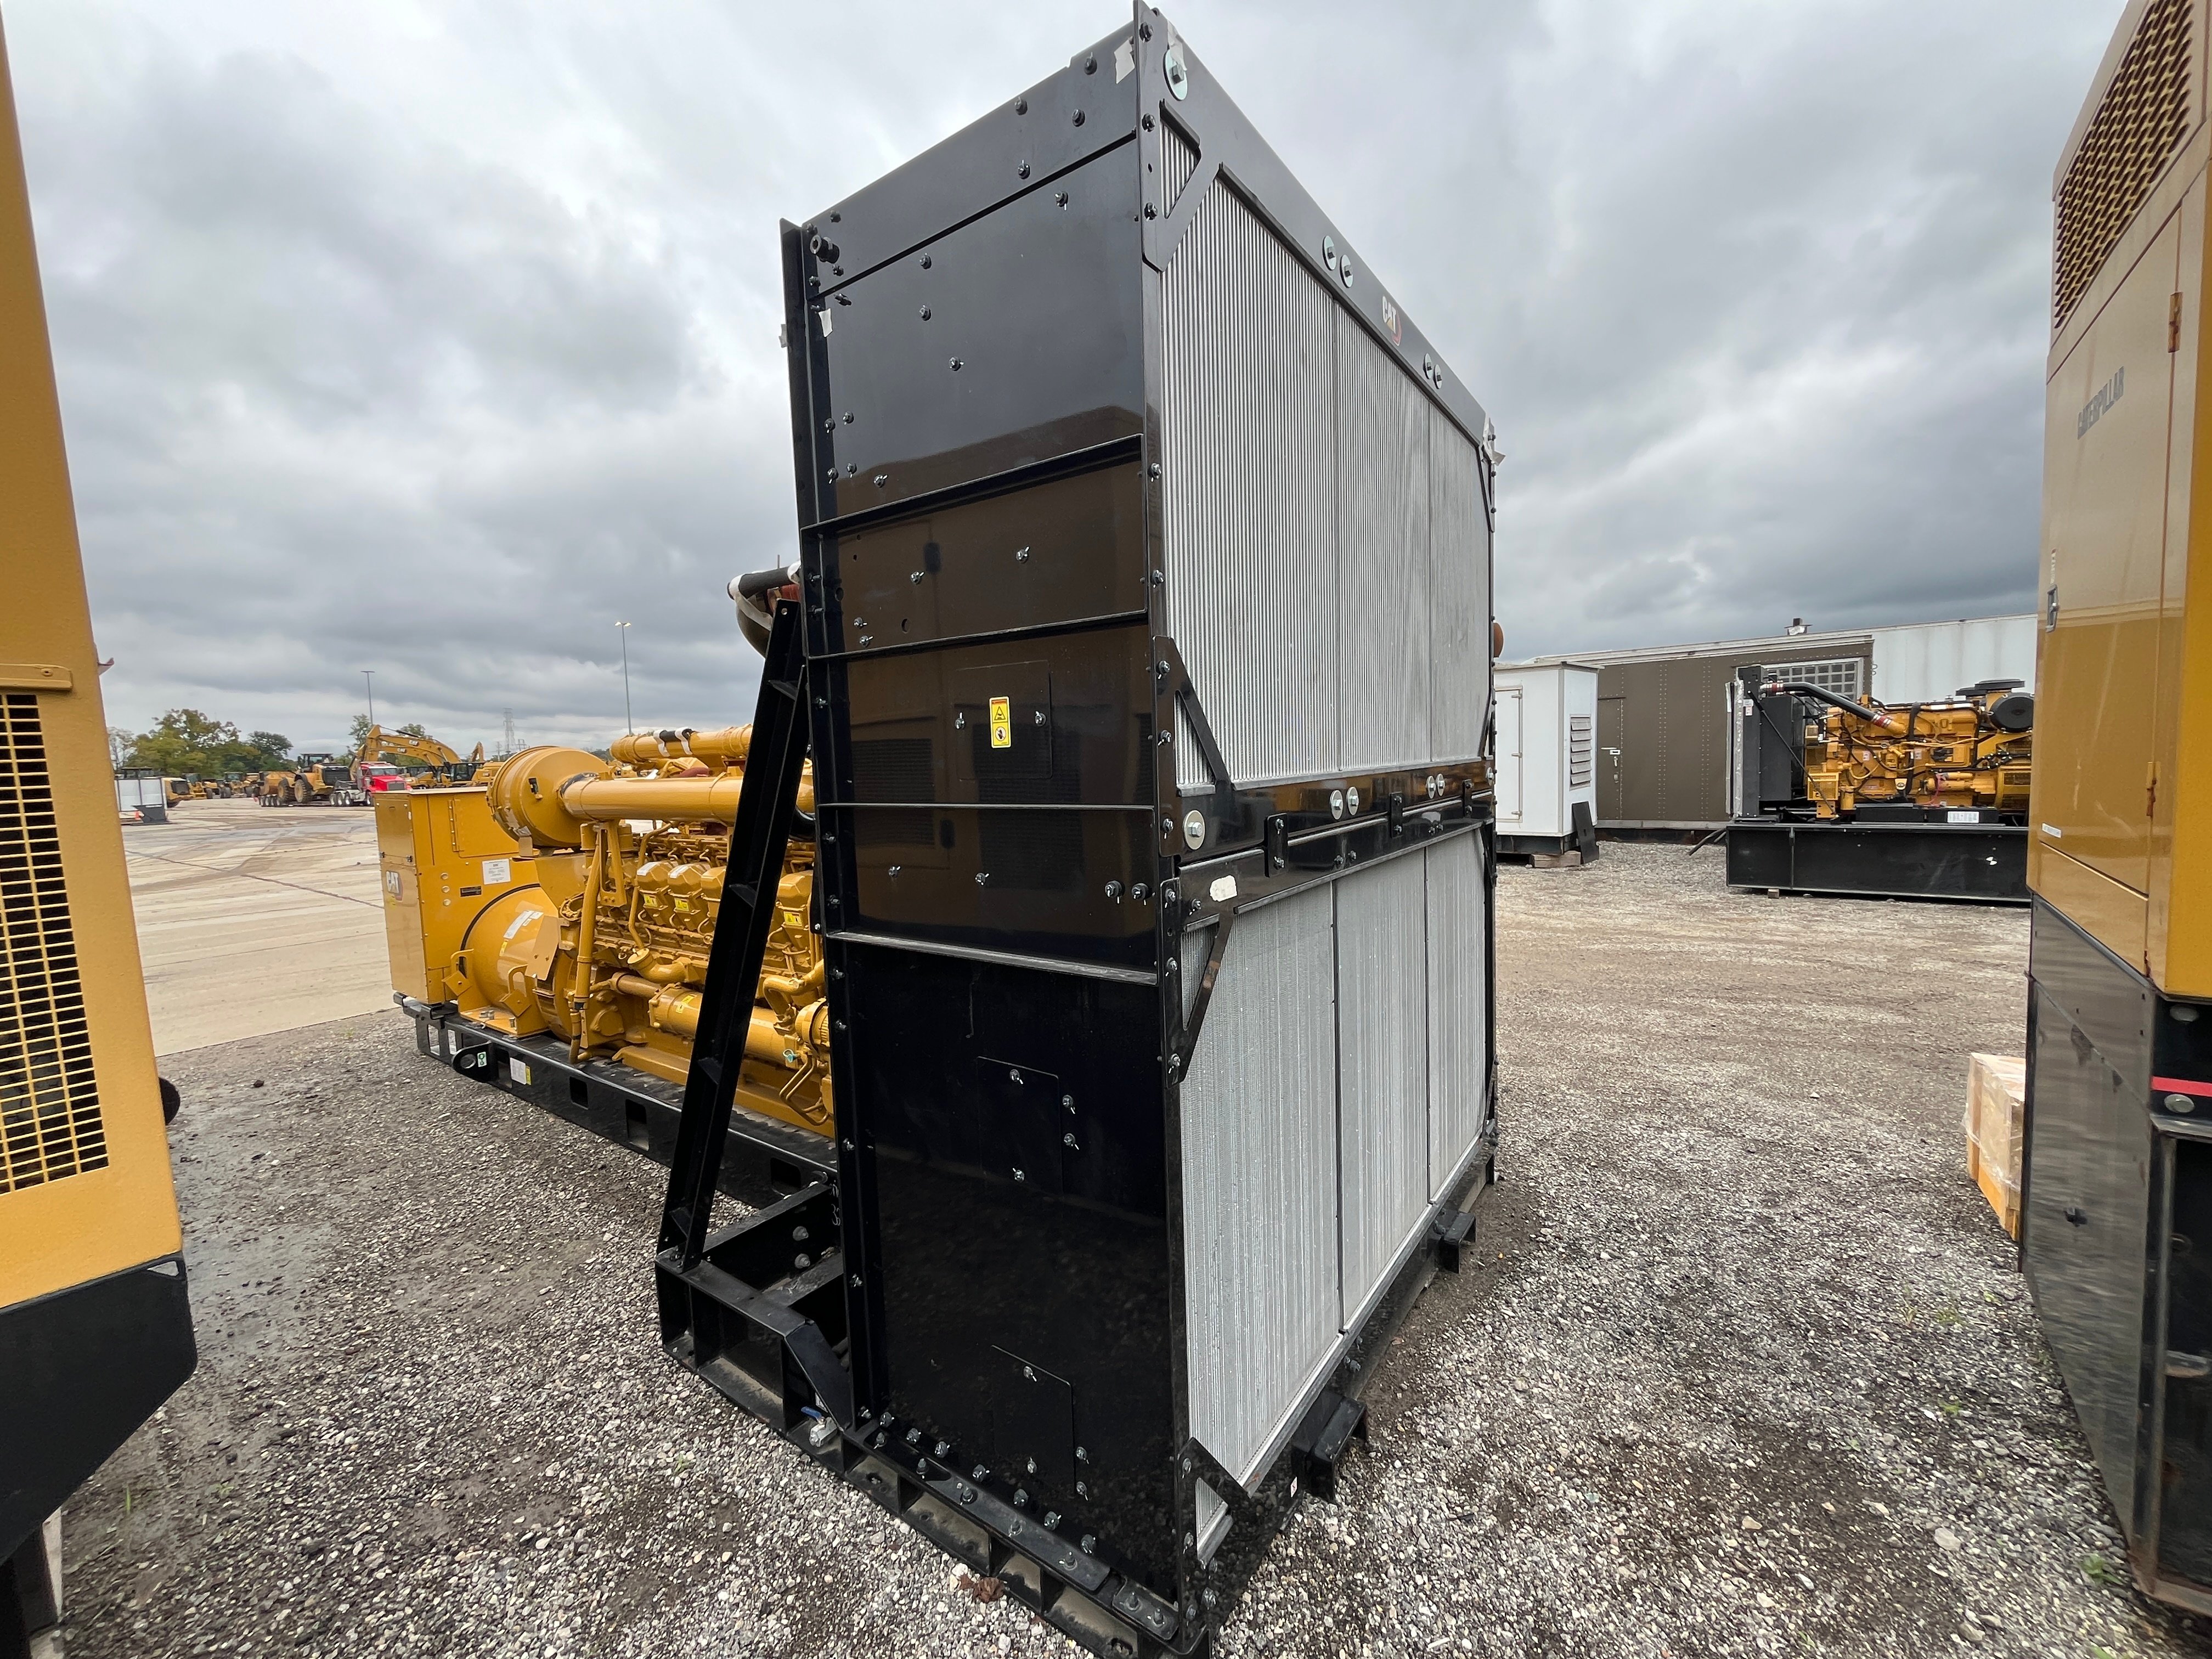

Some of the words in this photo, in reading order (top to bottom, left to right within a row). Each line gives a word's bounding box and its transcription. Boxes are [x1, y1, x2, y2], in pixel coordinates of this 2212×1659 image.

[1382, 296, 1397, 335] CAT
[2077, 365, 2124, 440] CATERPILLAR
[386, 871, 399, 894] CAT
